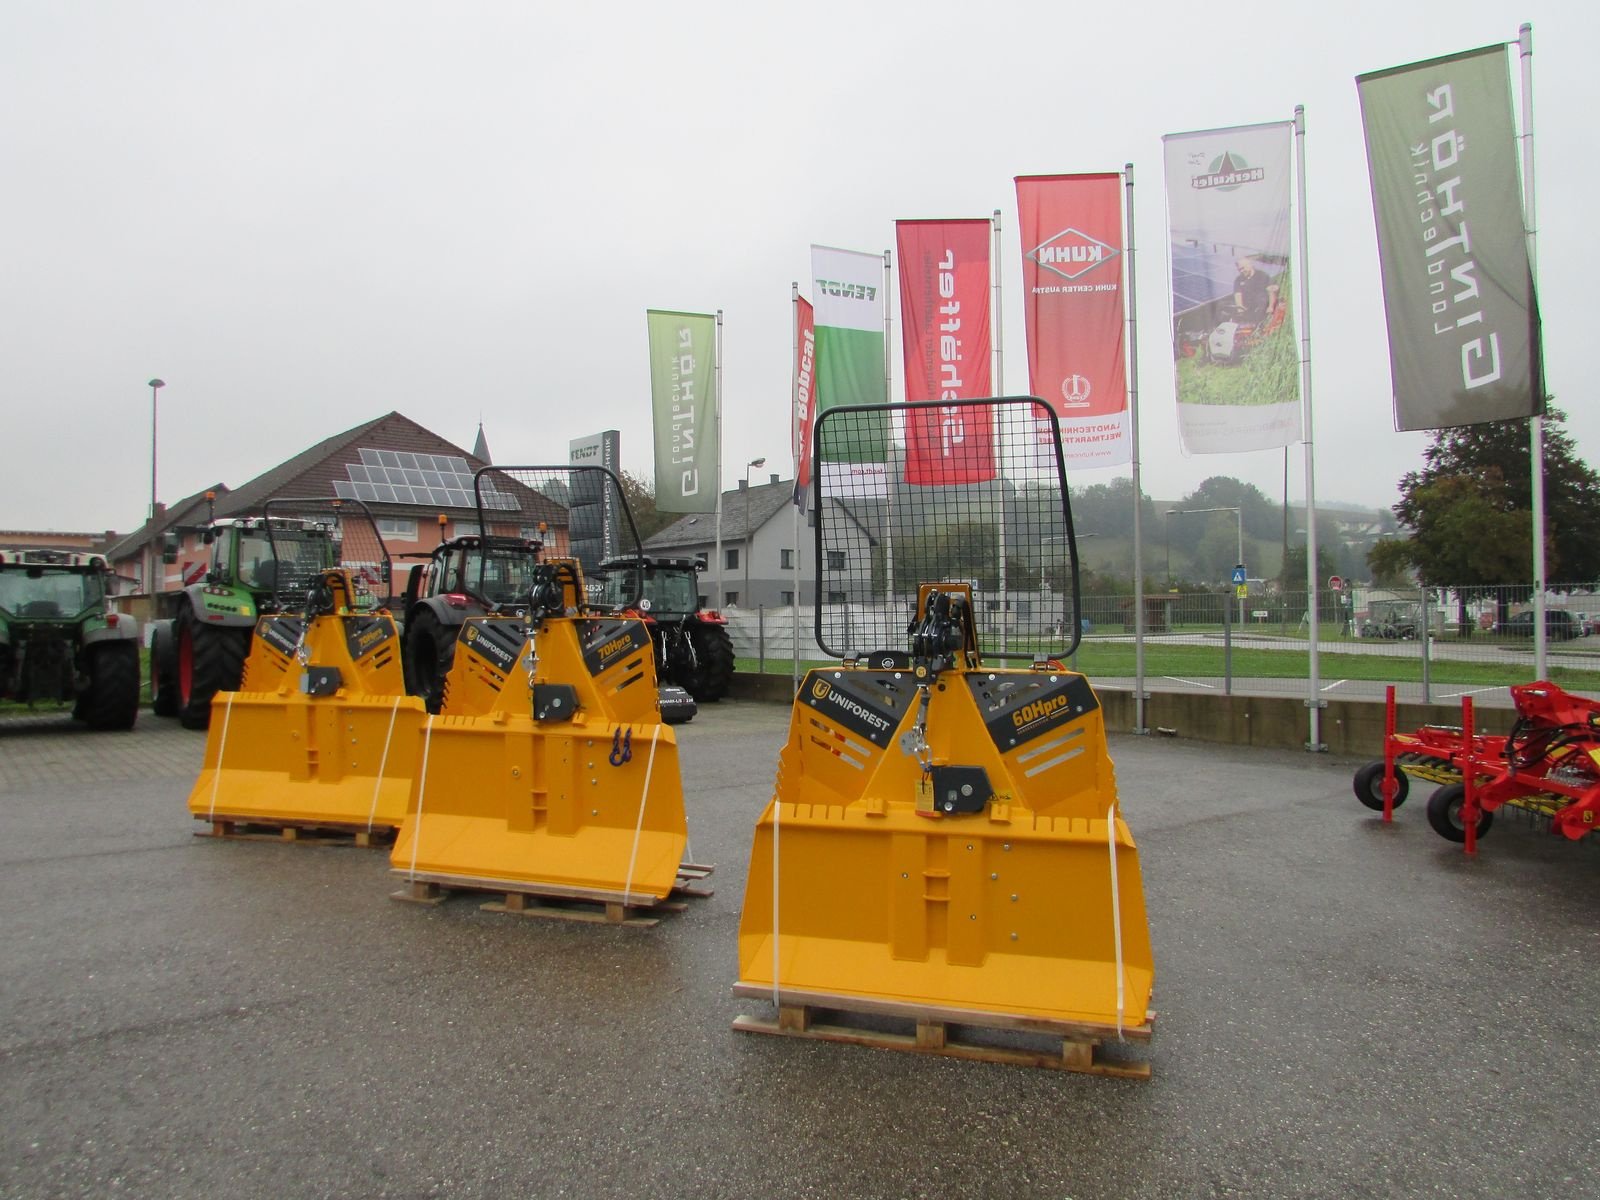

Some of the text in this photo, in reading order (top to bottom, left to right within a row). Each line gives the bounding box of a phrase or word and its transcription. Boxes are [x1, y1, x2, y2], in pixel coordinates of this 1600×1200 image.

[798, 329, 815, 421] Bobcat
[571, 445, 599, 461] FENDT
[476, 634, 513, 662] UNIFOREST
[598, 634, 631, 658] 70Hpro
[828, 689, 890, 732] UNIFOREST
[1012, 694, 1067, 726] 60Hpro
